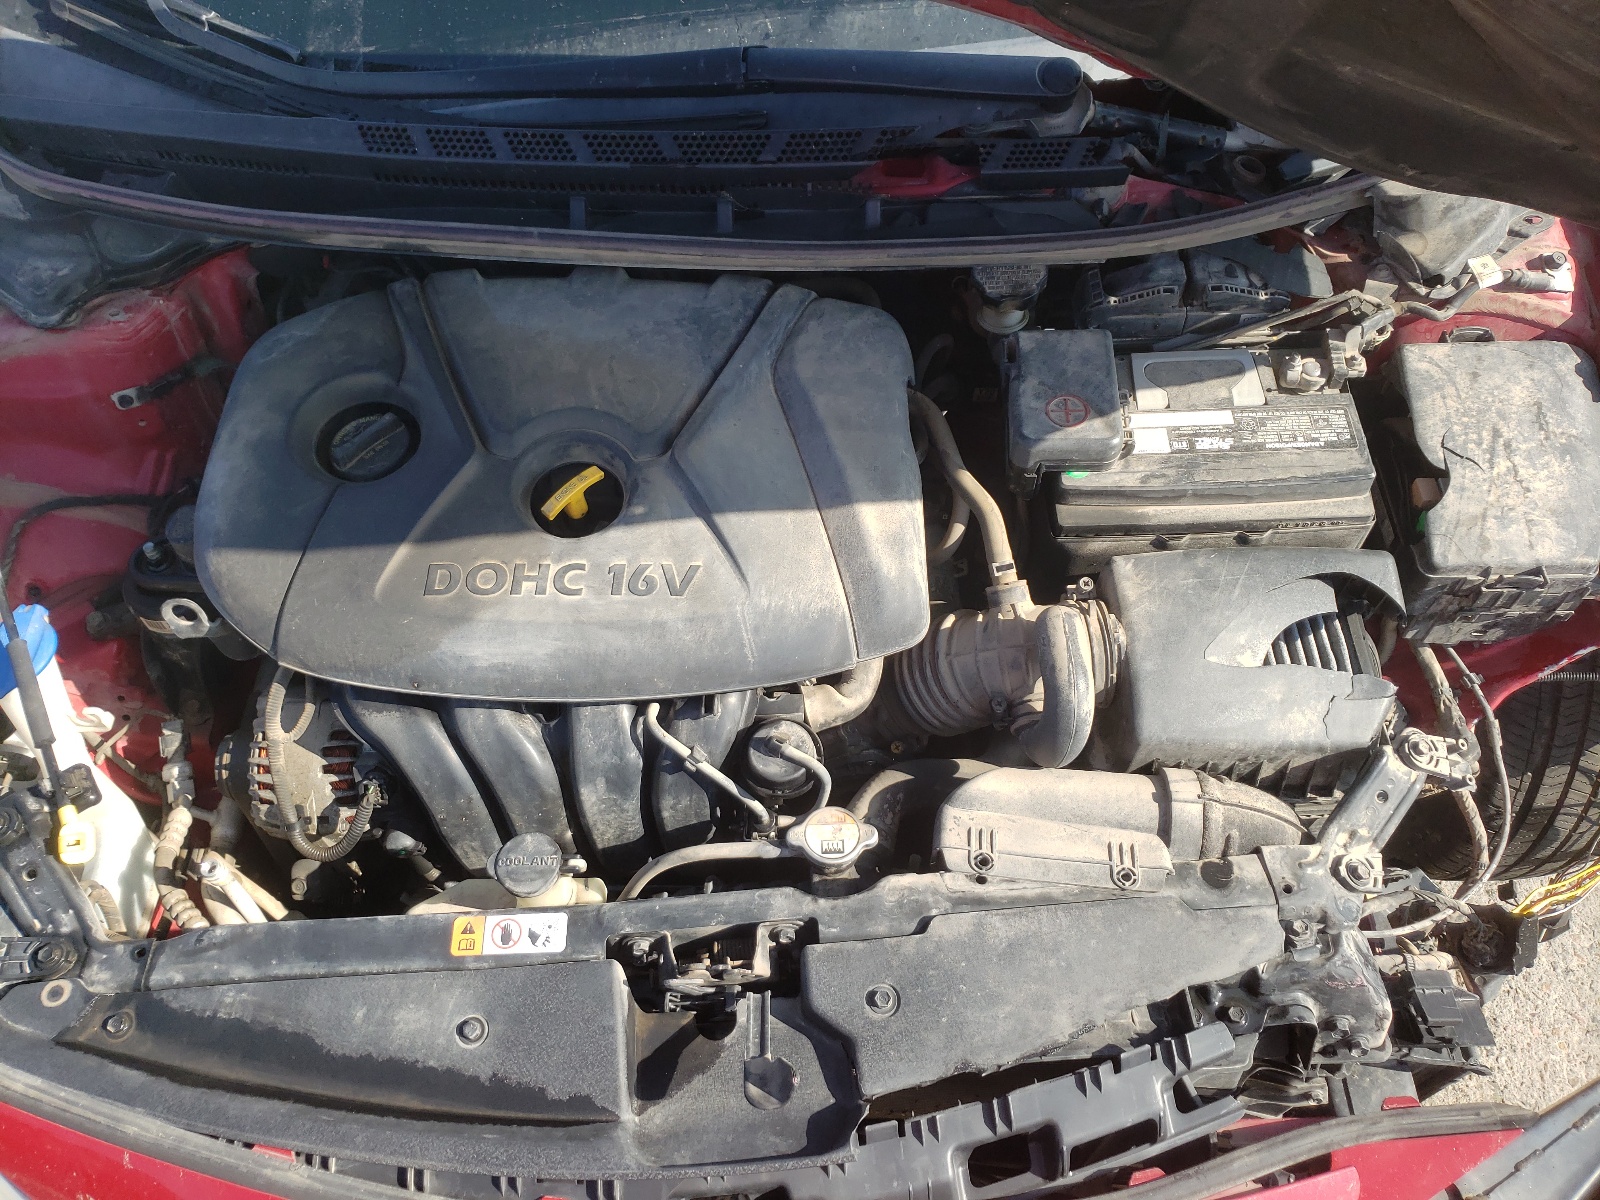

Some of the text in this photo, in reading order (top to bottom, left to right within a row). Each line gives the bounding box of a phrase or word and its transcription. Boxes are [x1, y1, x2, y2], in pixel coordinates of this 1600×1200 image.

[554, 480, 579, 503] ENGINE
[423, 562, 703, 598] DOHC 16V
[498, 855, 558, 868] COOLANT
